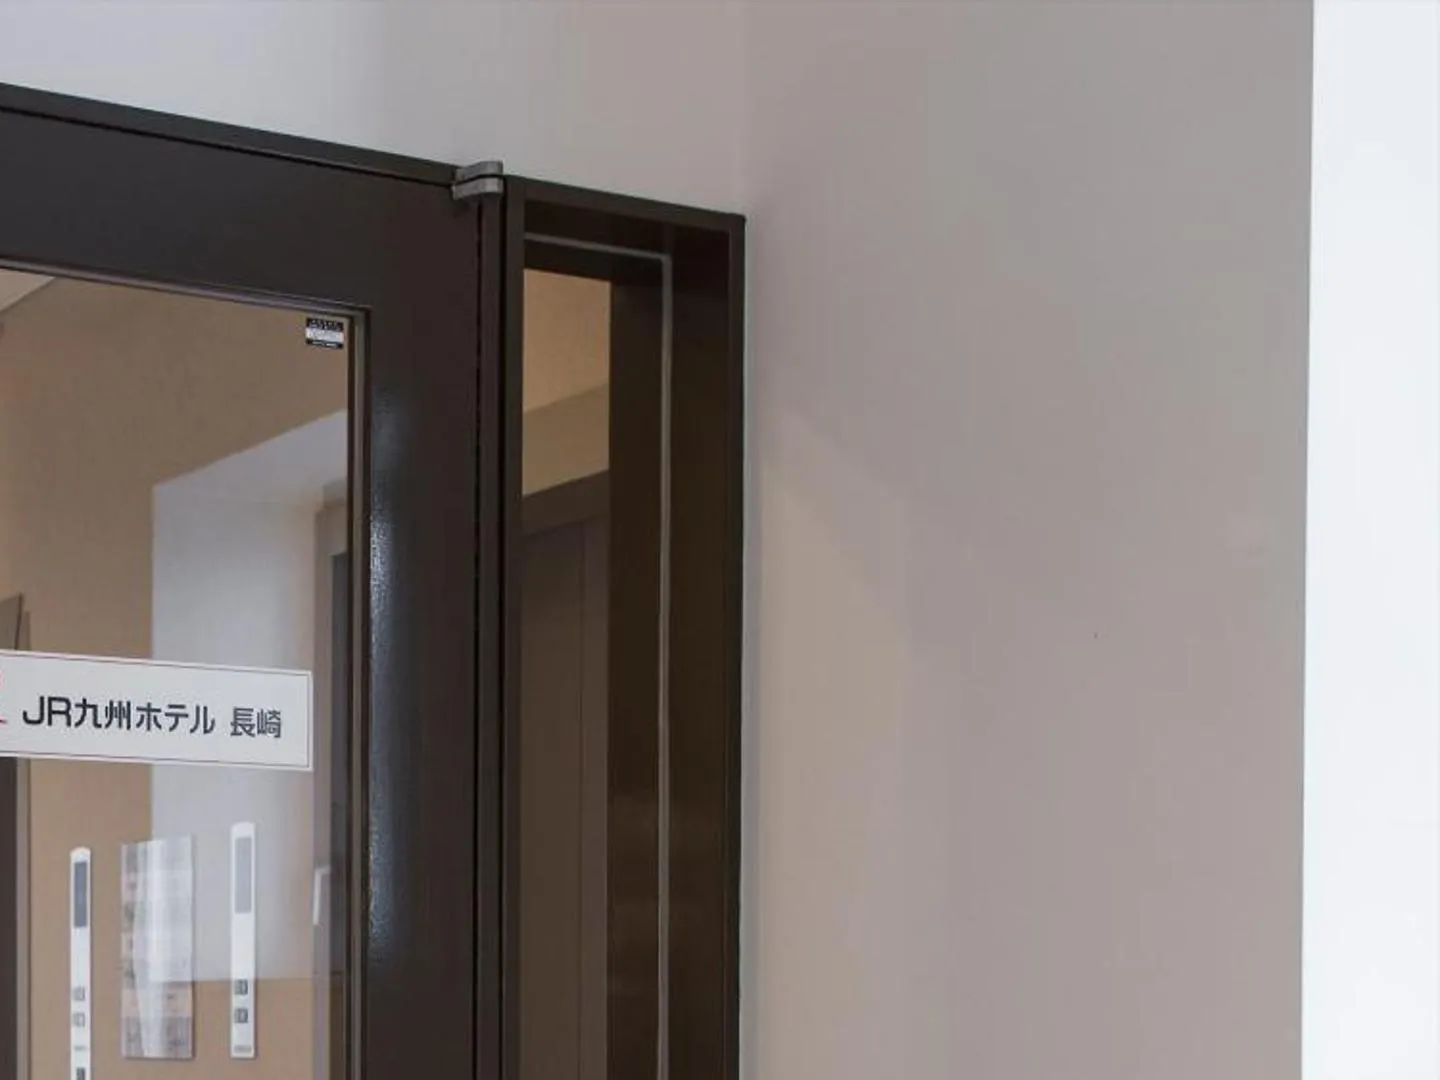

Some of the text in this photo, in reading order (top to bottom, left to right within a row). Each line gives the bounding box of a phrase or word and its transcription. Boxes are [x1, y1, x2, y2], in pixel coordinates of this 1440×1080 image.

[22, 696, 282, 738] JR九州ホテル 長崎
